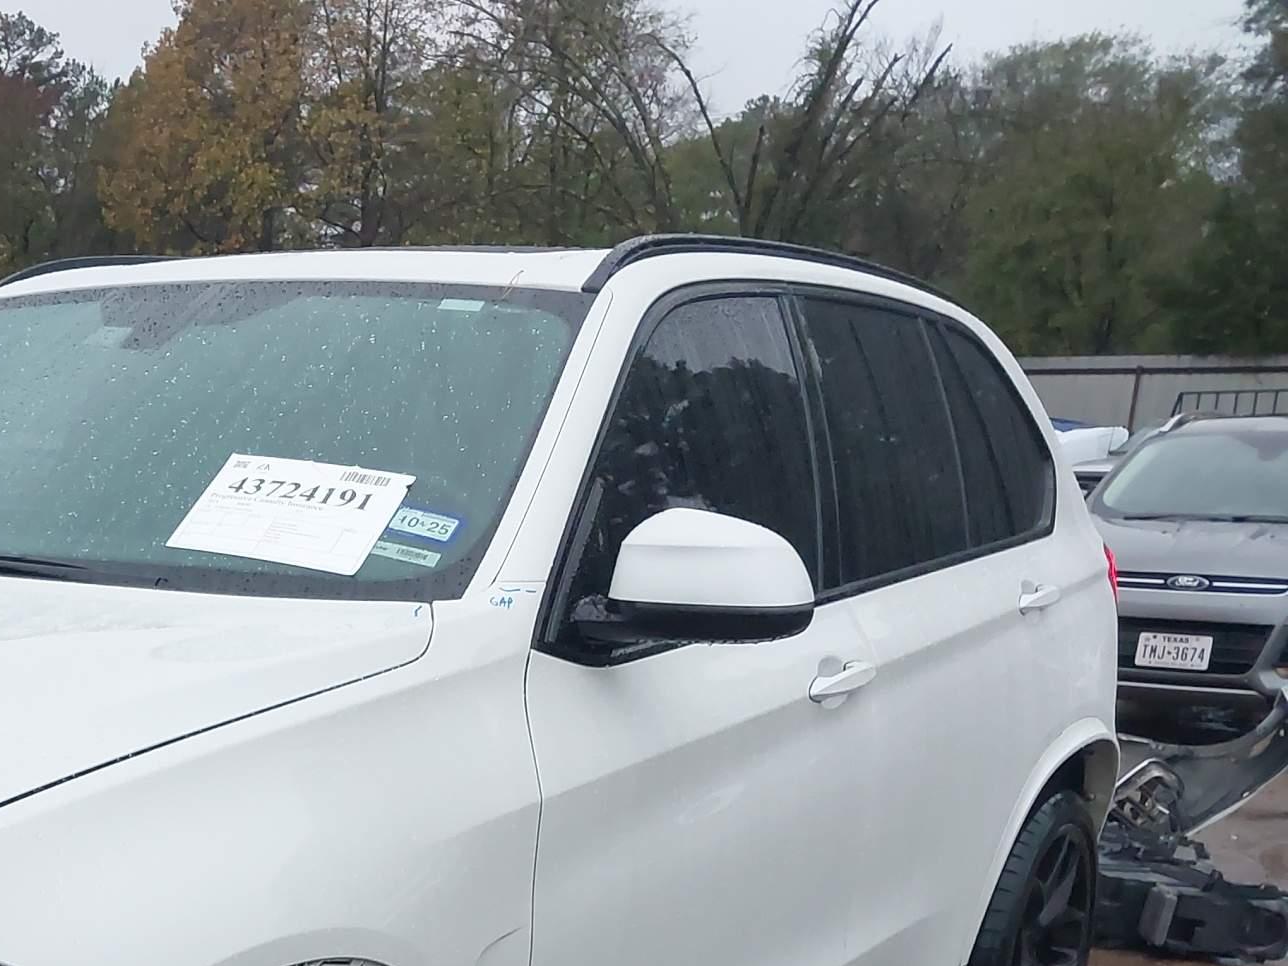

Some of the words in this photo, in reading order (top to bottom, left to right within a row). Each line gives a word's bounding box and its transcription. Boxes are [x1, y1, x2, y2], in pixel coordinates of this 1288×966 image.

[228, 476, 373, 510] 43724191
[489, 596, 514, 610] GAP
[1162, 635, 1190, 644] TEXAS
